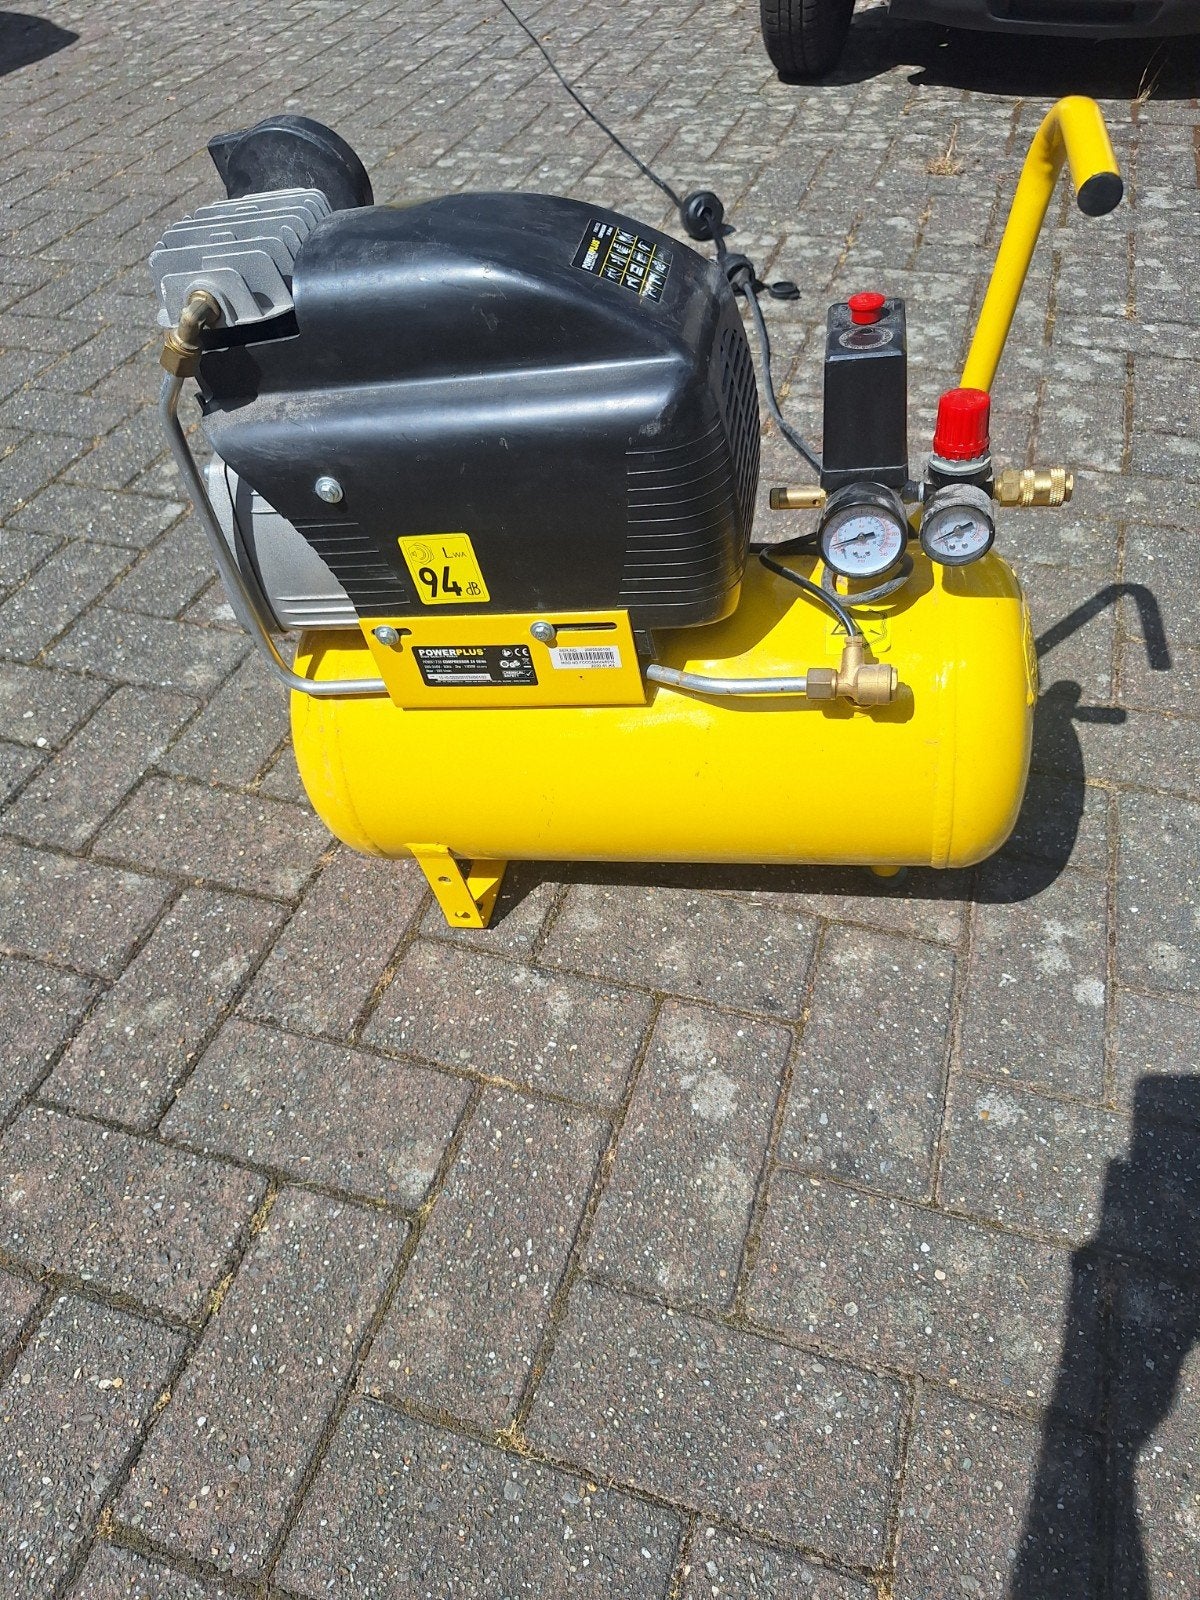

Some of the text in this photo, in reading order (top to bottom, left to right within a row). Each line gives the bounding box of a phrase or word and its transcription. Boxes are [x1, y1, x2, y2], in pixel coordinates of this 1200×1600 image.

[581, 239, 600, 271] POWERPLUS
[418, 566, 481, 598] 94 dB
[418, 648, 484, 656] POWERPLUS
